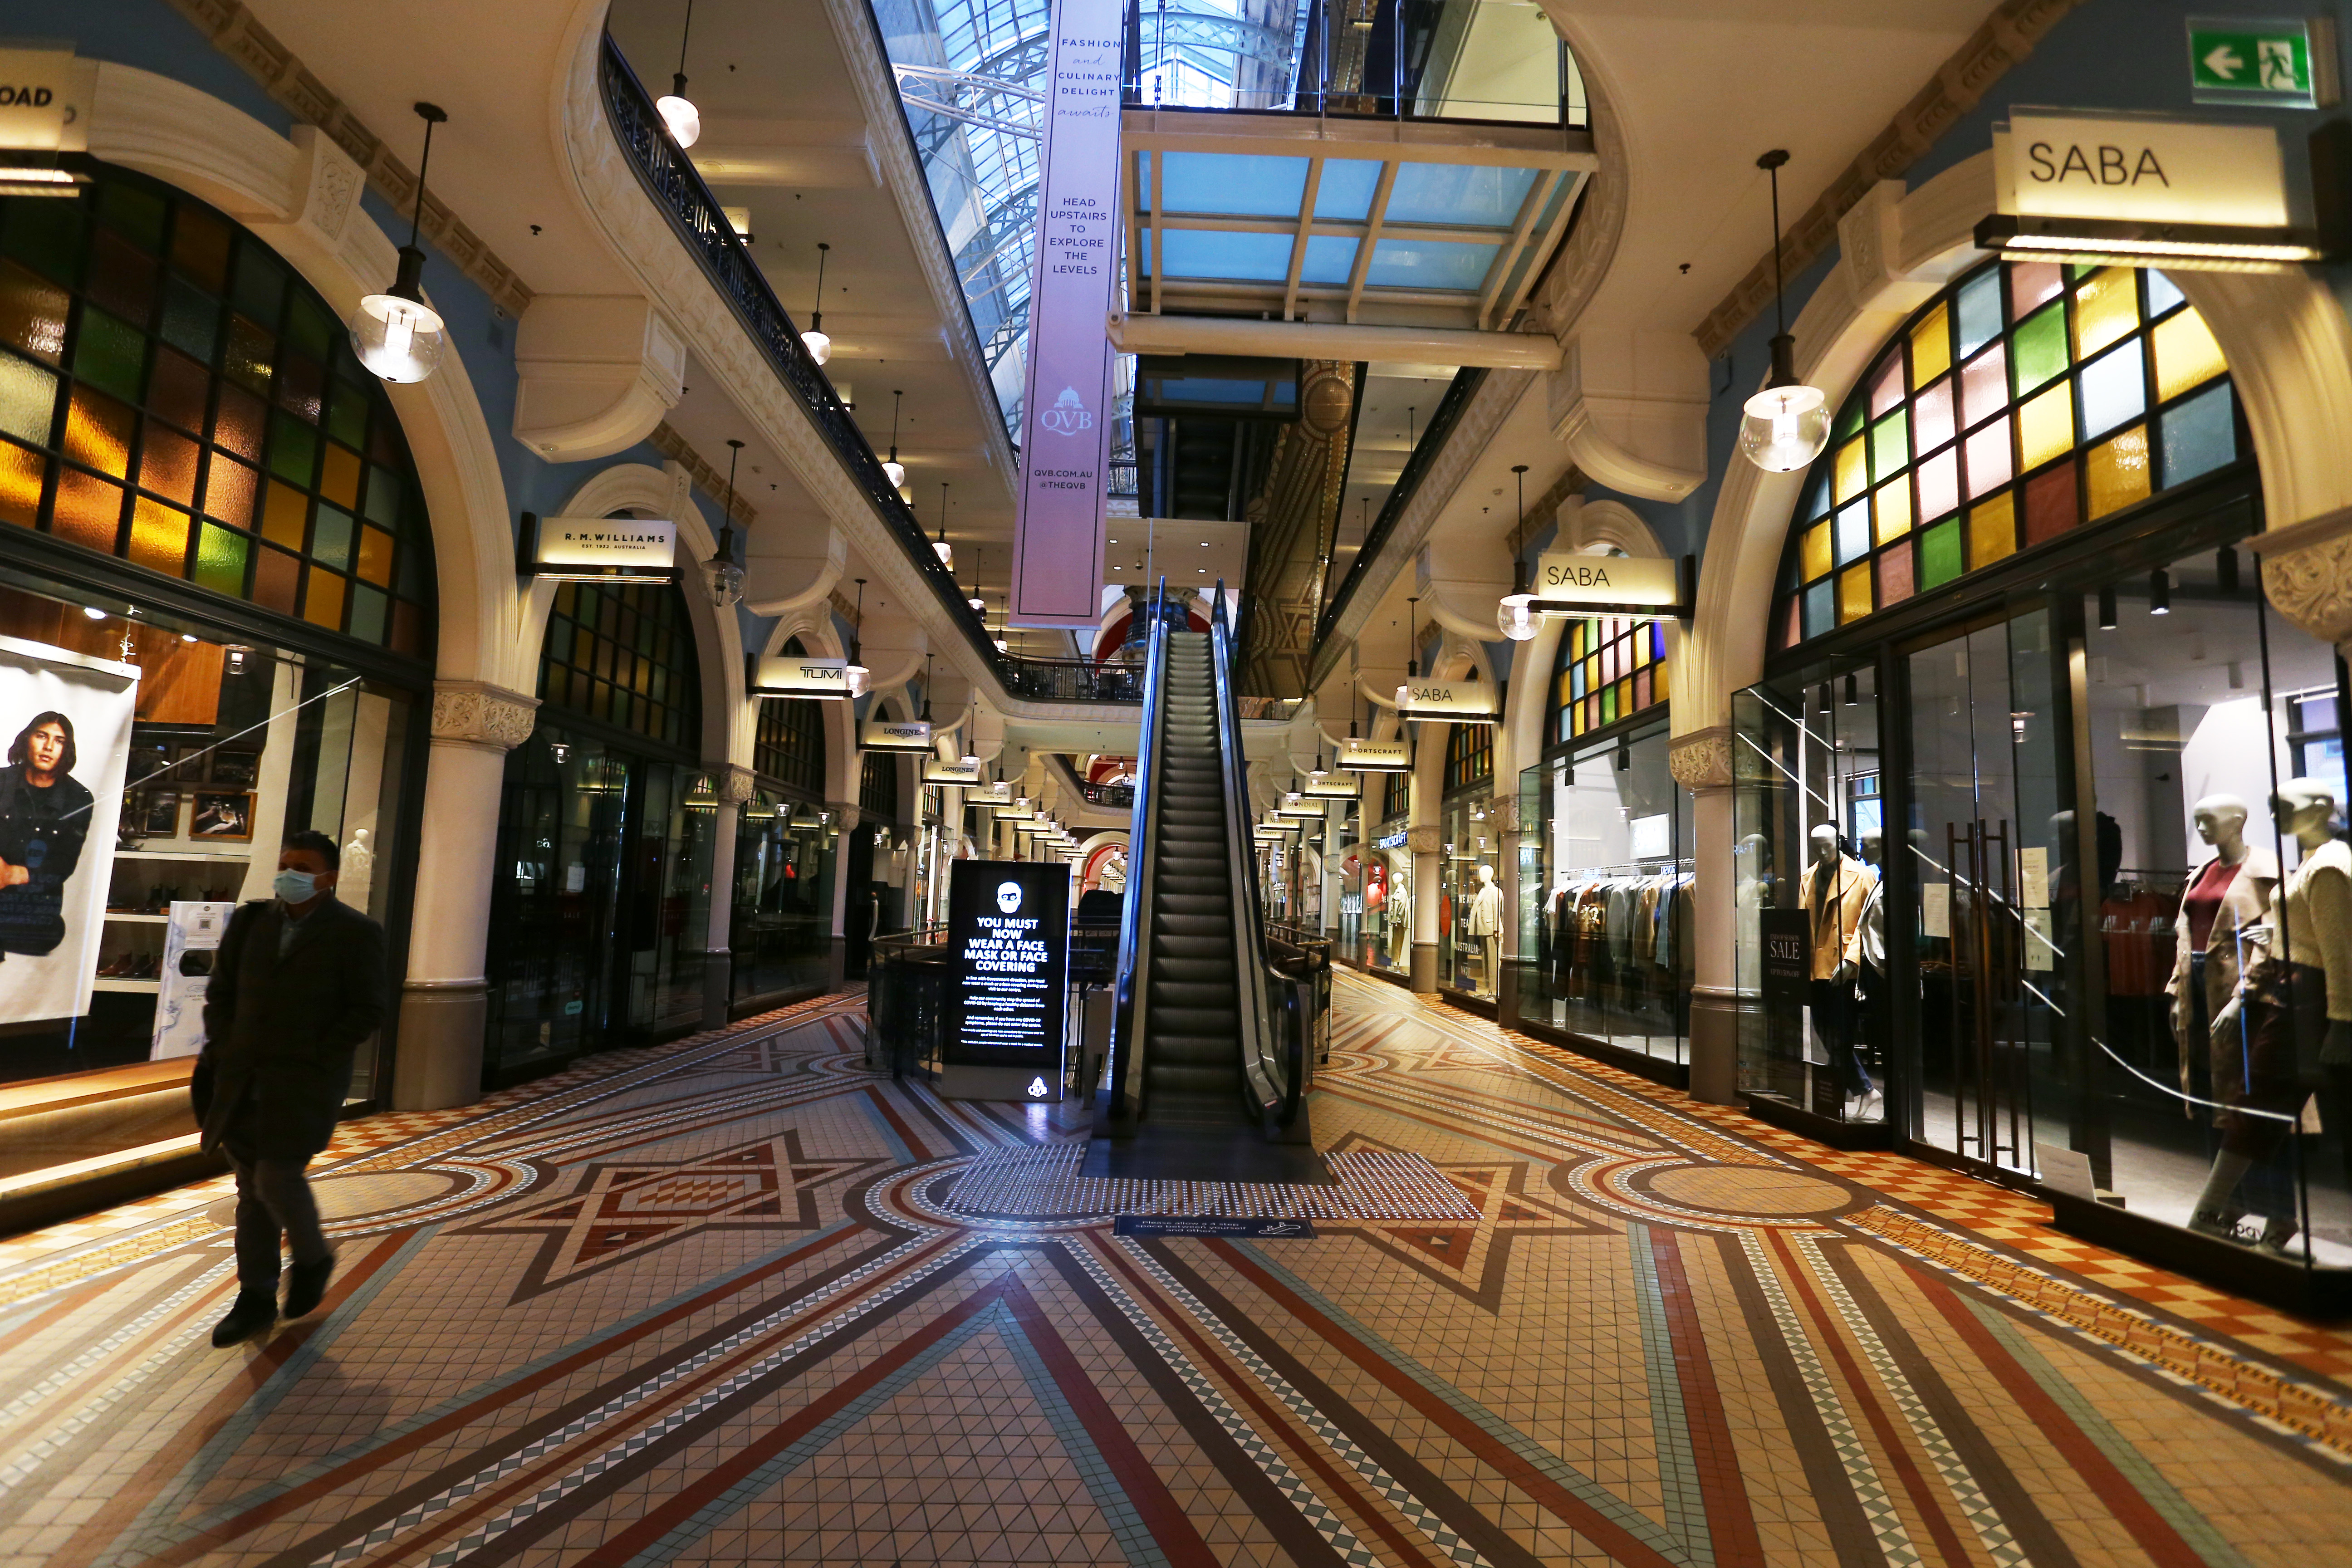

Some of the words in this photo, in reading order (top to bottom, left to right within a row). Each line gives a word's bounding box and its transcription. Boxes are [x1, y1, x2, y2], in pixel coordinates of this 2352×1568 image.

[1062, 39, 1120, 48] FASHION
[1073, 54, 1105, 65] and
[1058, 73, 1120, 81] CULINARY
[1062, 88, 1114, 96] DELIGHT
[1058, 105, 1114, 118] awaits
[2029, 142, 2170, 188] SABA
[1063, 198, 1096, 206] HEAD
[1051, 211, 1107, 220] UPSTAIRS
[1070, 225, 1085, 233] TO
[1050, 238, 1104, 247] EXPLORE
[1065, 252, 1087, 260] THE
[1053, 265, 1097, 274] LEVELS
[1041, 410, 1093, 436] QVB
[1034, 470, 1093, 478] QVB.COM.AU
[1040, 481, 1086, 490] @THEQVB
[1548, 566, 1610, 587] SABA
[800, 666, 842, 679] TUMI
[1412, 688, 1453, 701] SABA
[1379, 832, 1406, 849] SPORTSCRAFT
[977, 917, 1001, 927] YOU
[1004, 918, 1039, 929] MUST
[992, 929, 1023, 939] NOW
[969, 938, 1003, 950] WEAR
[1005, 940, 1014, 950] A
[1017, 940, 1044, 951] FACE
[965, 949, 998, 960] MASK
[1000, 951, 1017, 960] OR
[1020, 951, 1048, 962] FACE
[1770, 941, 1799, 960] SALE
[975, 960, 1035, 972] COVERING
